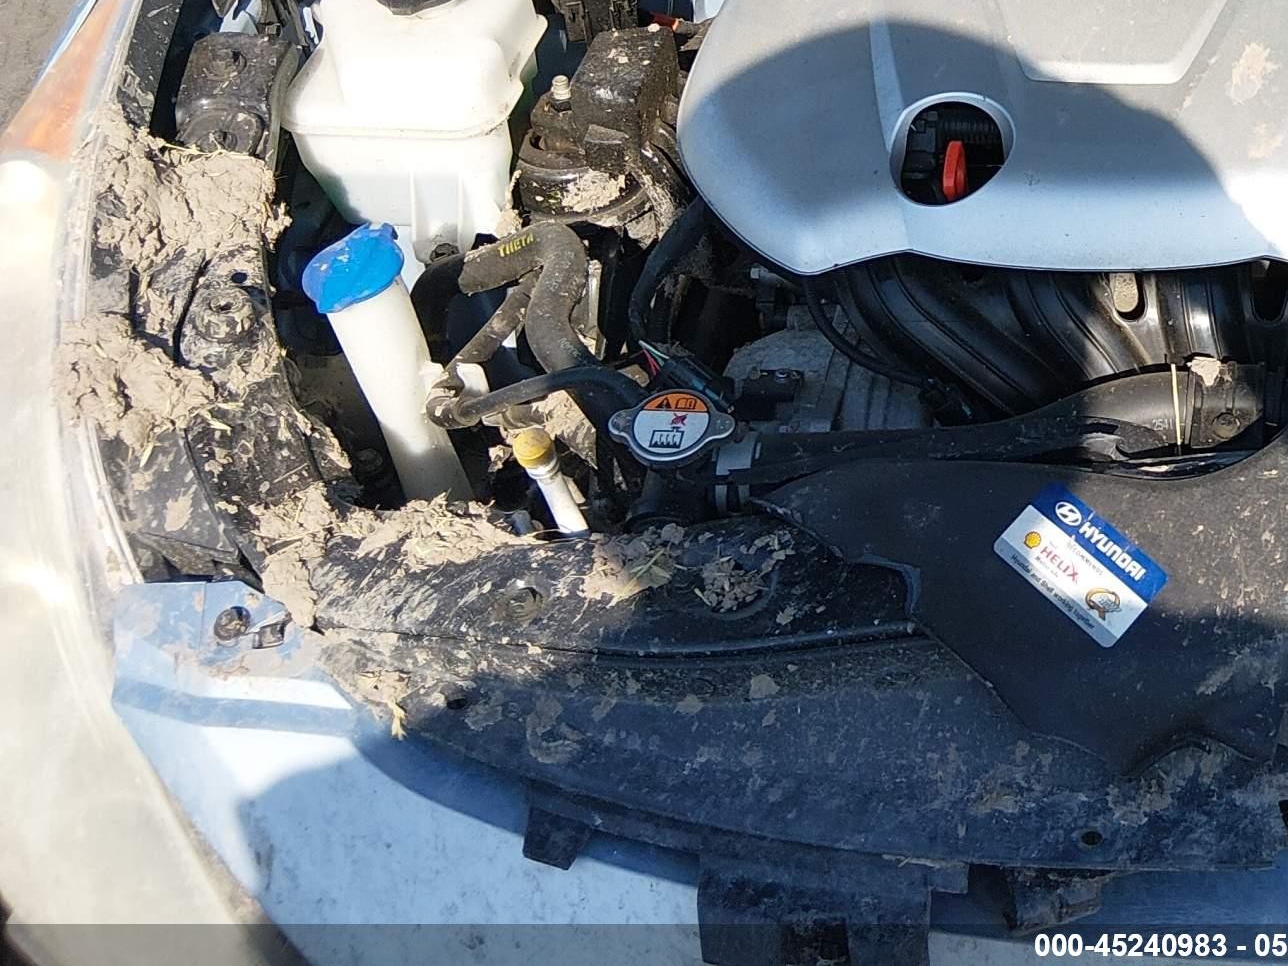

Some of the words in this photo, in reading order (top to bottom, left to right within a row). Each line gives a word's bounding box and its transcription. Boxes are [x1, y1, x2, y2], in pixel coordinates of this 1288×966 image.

[1010, 553, 1033, 574] Hyundai
[1040, 546, 1079, 584] HELIX
[1079, 521, 1146, 581] HYUNDAI
